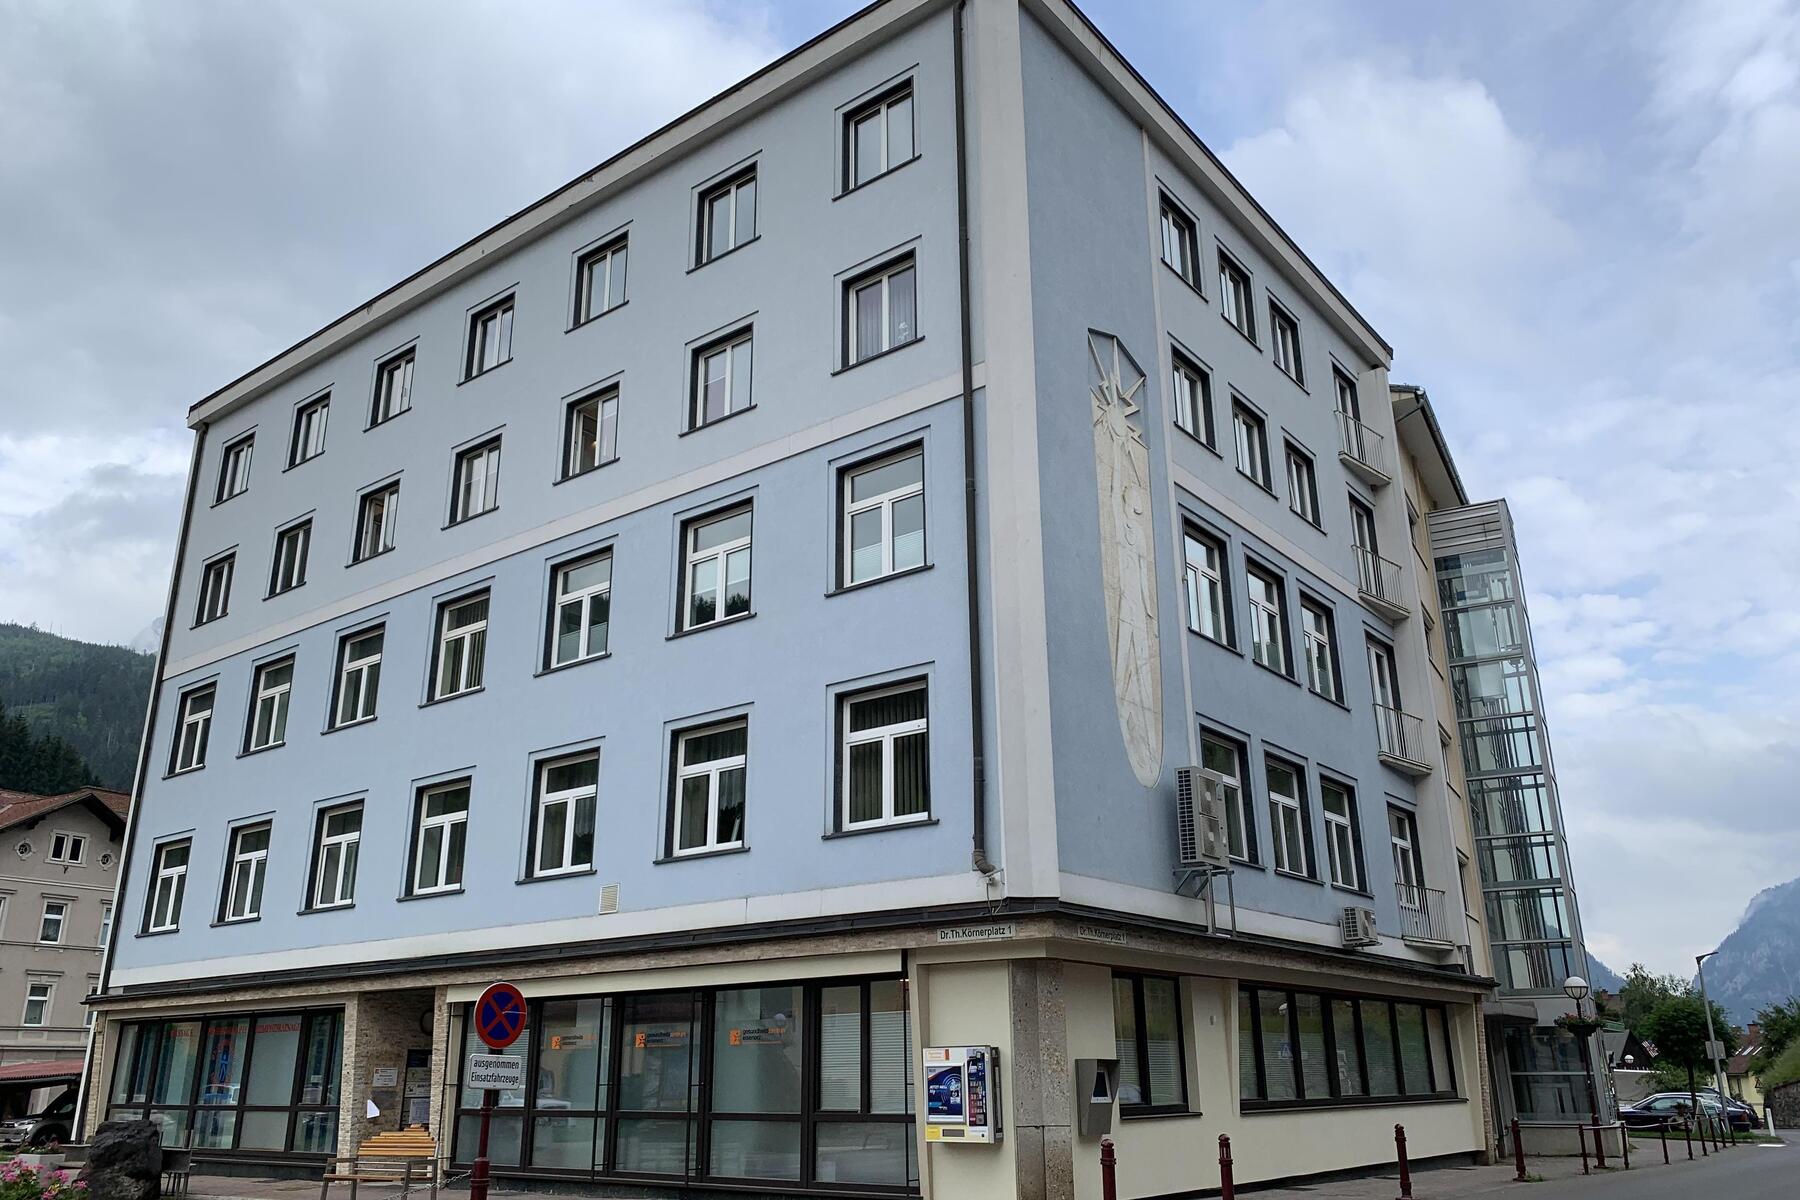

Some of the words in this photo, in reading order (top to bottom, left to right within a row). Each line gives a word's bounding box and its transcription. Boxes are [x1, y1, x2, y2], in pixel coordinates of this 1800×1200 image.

[940, 926, 1005, 939] Dr.Th.Körnerplatz
[1007, 925, 1012, 934] 1
[473, 1060, 520, 1070] ausgenommen
[471, 1072, 519, 1085] Einsatzfahrzeuge
